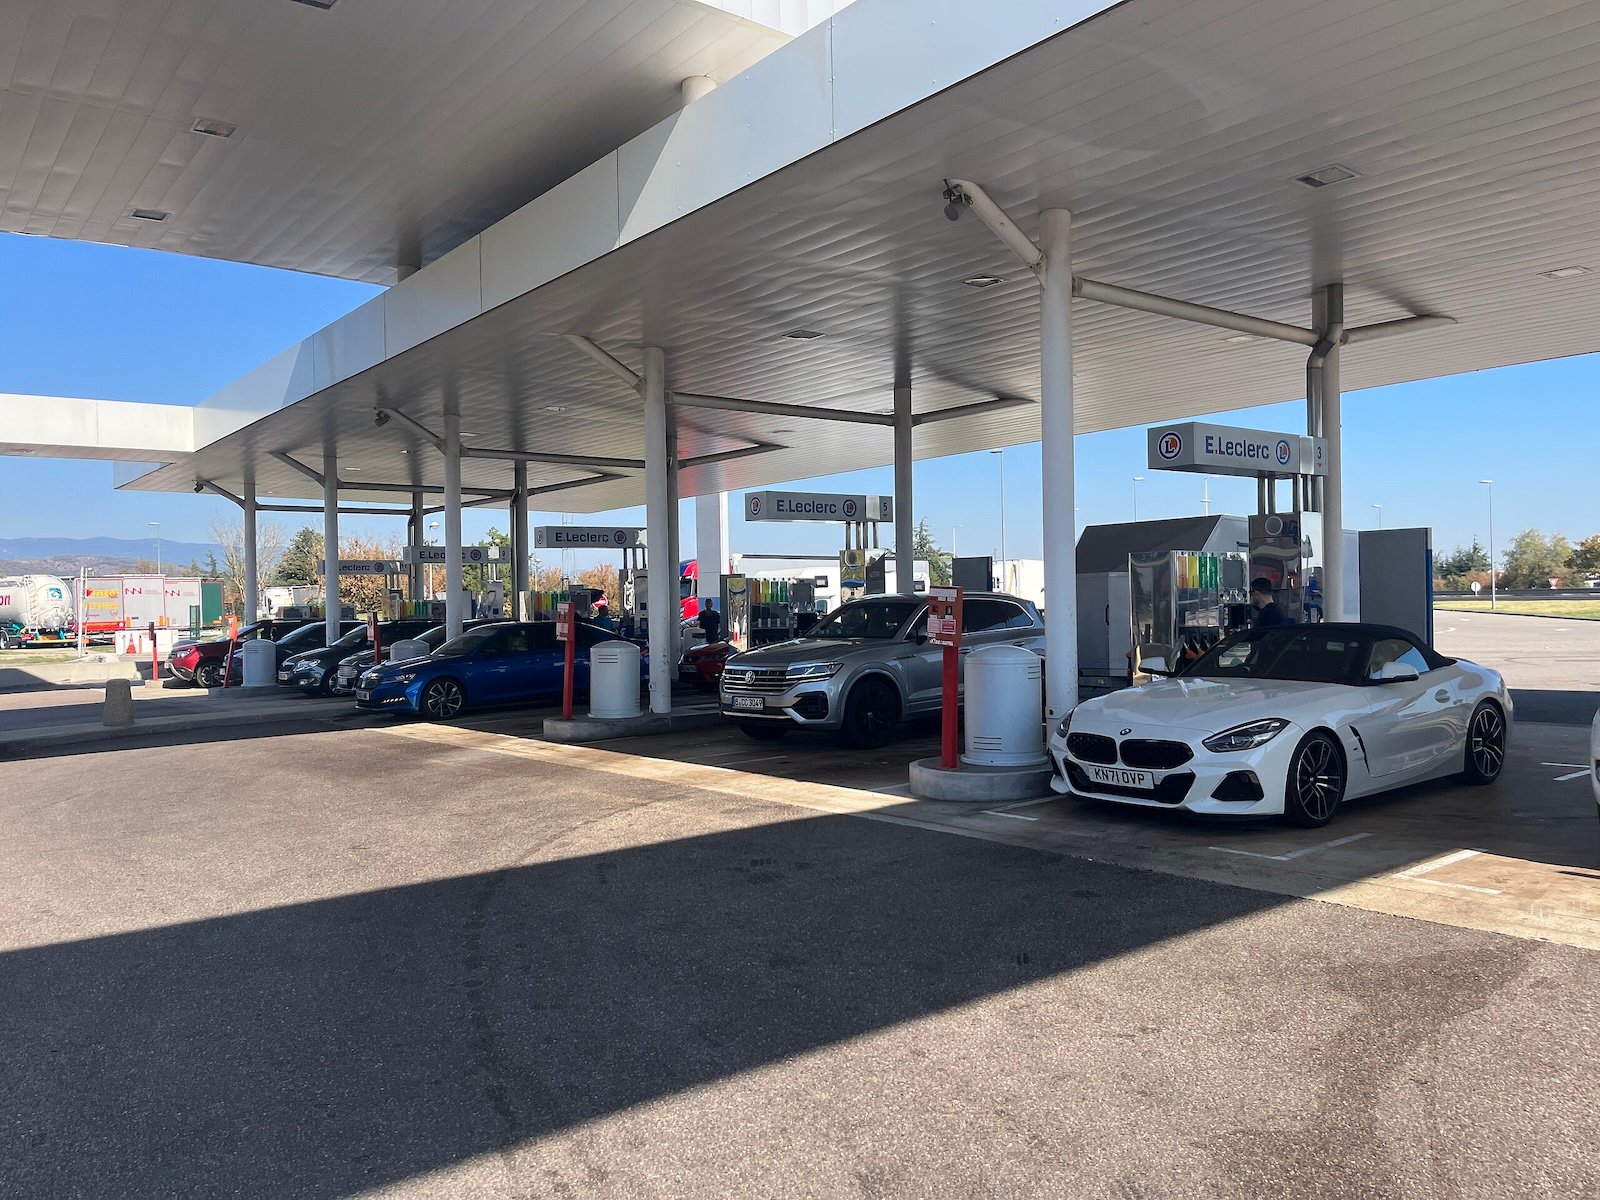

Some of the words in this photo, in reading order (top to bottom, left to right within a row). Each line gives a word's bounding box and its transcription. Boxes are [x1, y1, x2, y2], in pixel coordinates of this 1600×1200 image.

[1205, 435, 1270, 460] E.Leclerc
[1317, 446, 1323, 459] 3
[776, 499, 837, 514] E.Leclerc
[883, 502, 888, 511] 5
[555, 532, 609, 543] E.Leclerc
[420, 551, 466, 559] E.Lecc
[1094, 767, 1120, 783] KN71
[1122, 771, 1145, 785] OVP
